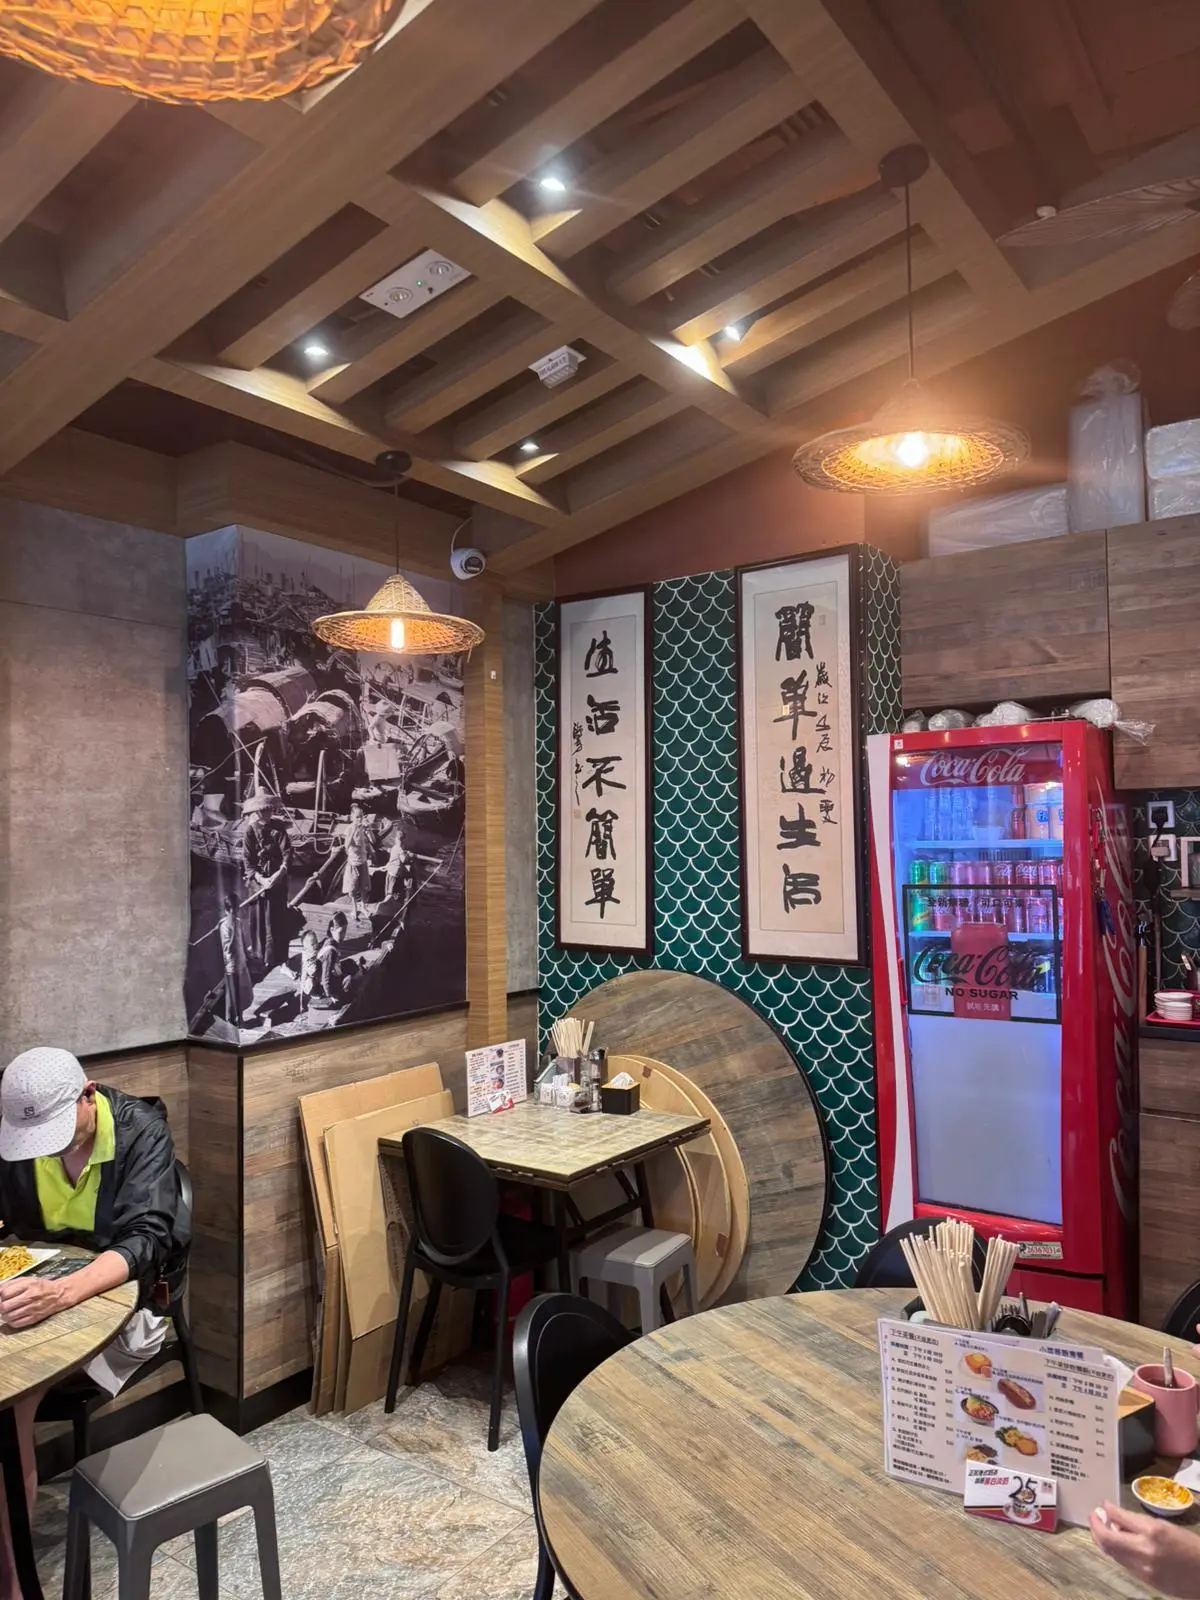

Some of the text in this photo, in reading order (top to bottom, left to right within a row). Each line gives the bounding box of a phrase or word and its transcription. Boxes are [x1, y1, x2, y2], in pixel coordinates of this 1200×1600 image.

[920, 747, 1032, 786] Coca-Cola
[913, 944, 1043, 987] Coca-Cola
[945, 986, 1019, 1000] NO SUGAR
